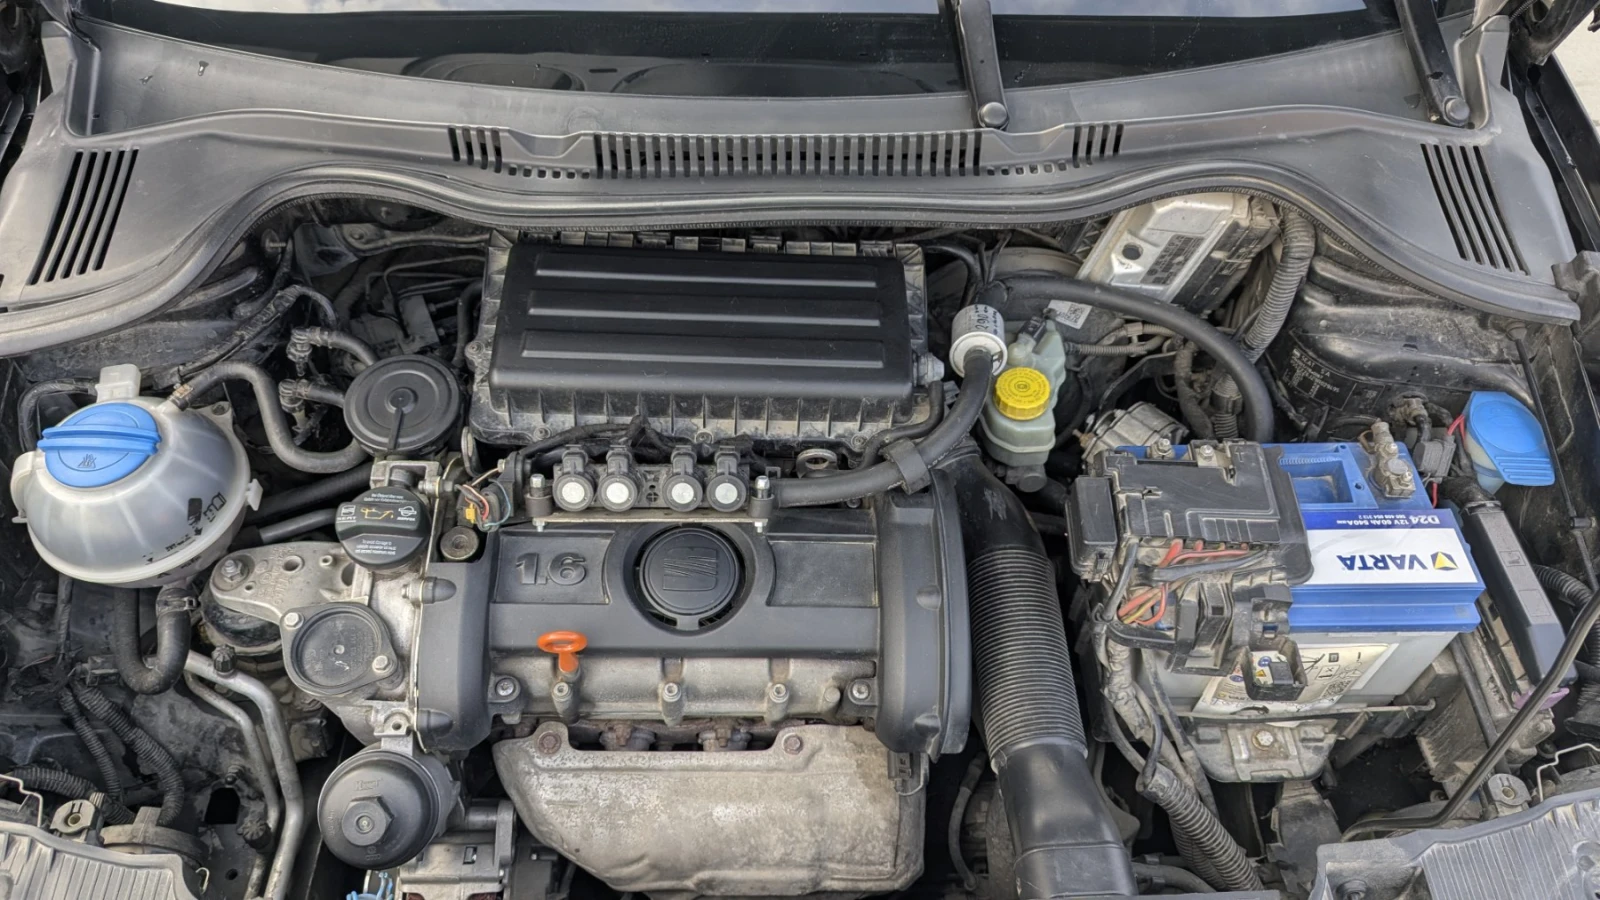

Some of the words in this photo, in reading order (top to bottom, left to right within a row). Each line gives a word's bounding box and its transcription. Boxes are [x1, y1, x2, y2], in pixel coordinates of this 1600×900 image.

[1409, 514, 1441, 525] D24
[516, 552, 587, 586] 1.6
[1336, 554, 1429, 571] VARTA
